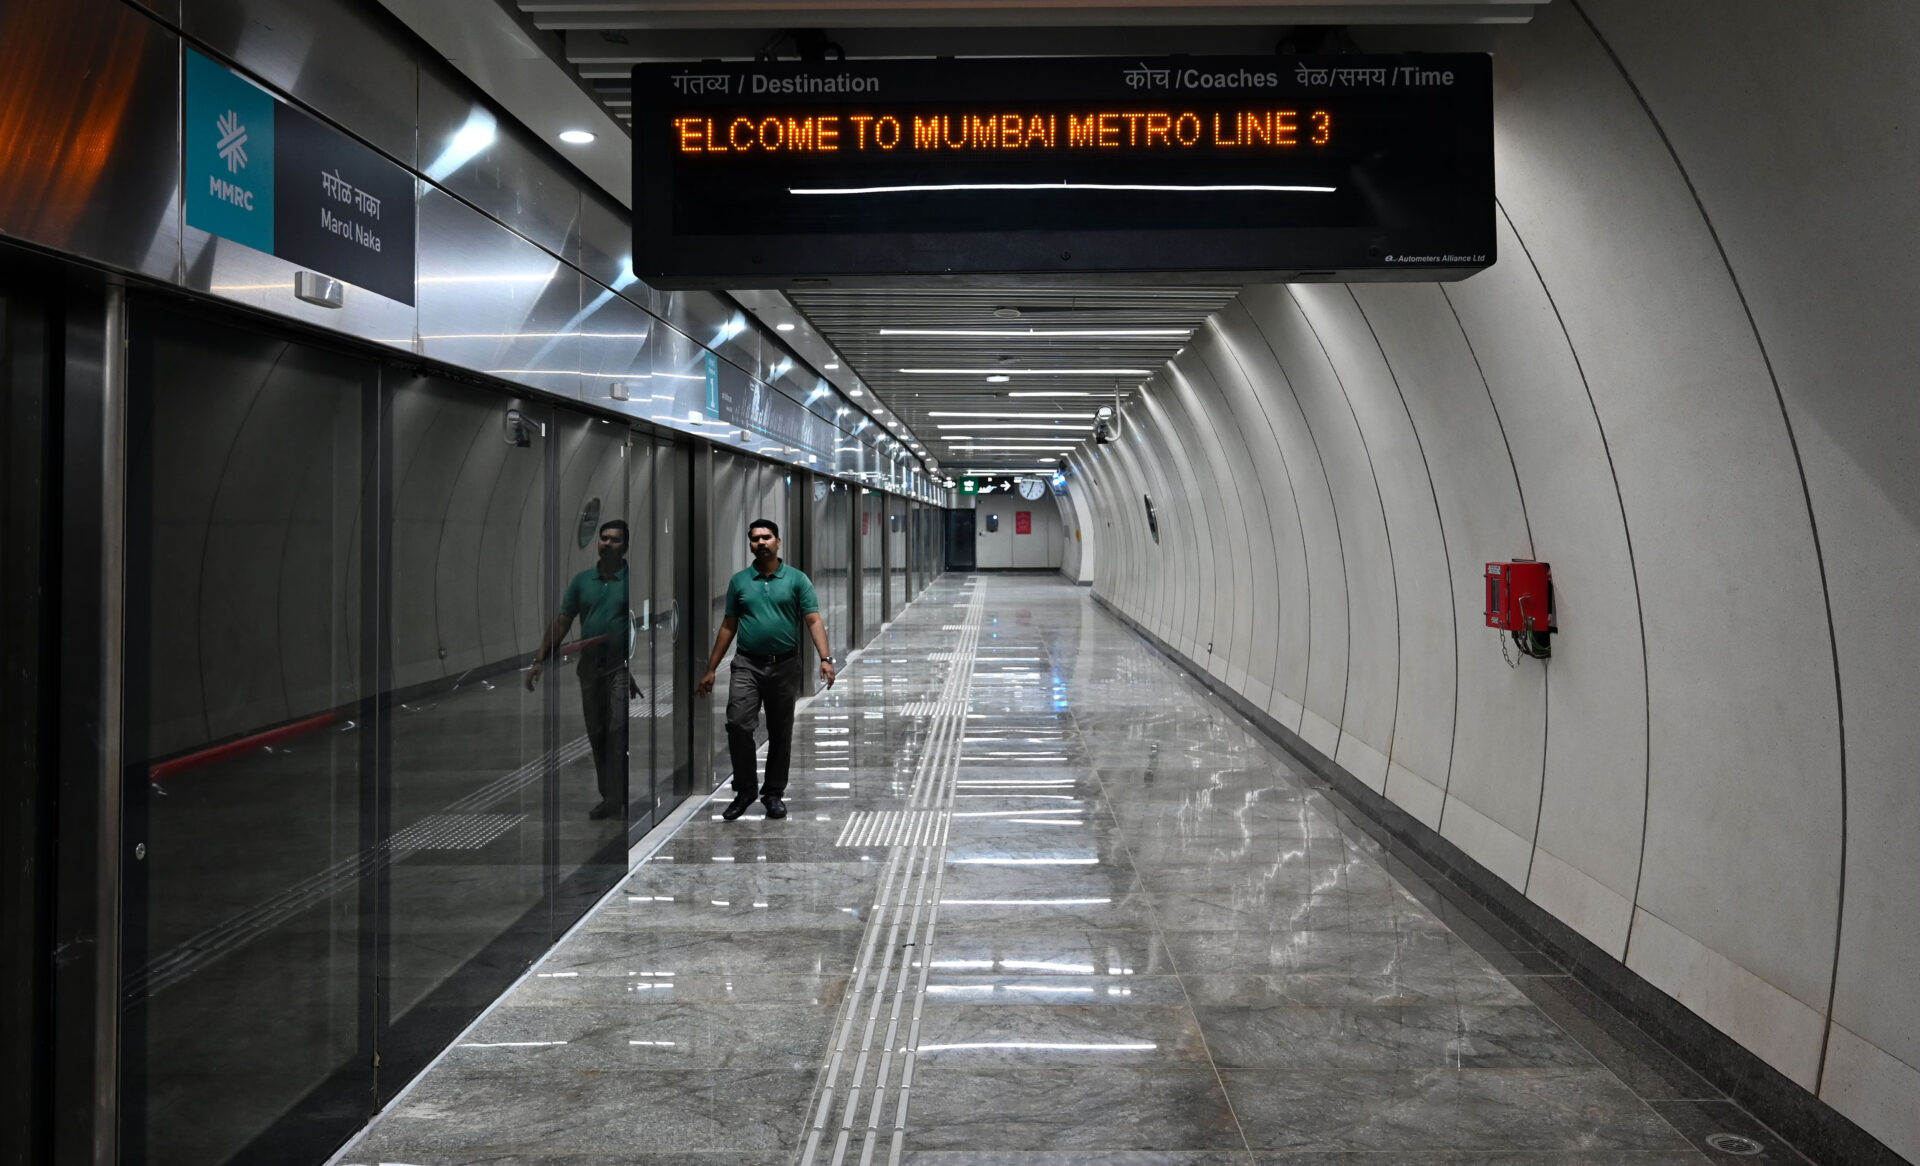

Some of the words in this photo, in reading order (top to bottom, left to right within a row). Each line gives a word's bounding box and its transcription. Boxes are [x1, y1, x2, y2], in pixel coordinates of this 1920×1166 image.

[671, 69, 731, 95] गंतव्य
[752, 73, 879, 94] Destination
[1122, 62, 1171, 90] कोच
[672, 116, 839, 152] ELCOME
[850, 115, 901, 150] TO
[913, 114, 1056, 149] MUMBAI
[1068, 112, 1201, 147] METRO
[1214, 111, 1297, 145] LINE
[1311, 111, 1330, 144] 3
[209, 175, 254, 212] MMRC
[321, 169, 353, 205] मरोळ
[354, 188, 381, 221] नाका
[321, 207, 353, 241] Marol
[355, 223, 381, 252] Naka
[1398, 254, 1441, 263] Autometers
[1441, 254, 1471, 263] Alliance
[1472, 253, 1486, 263] Ltd
